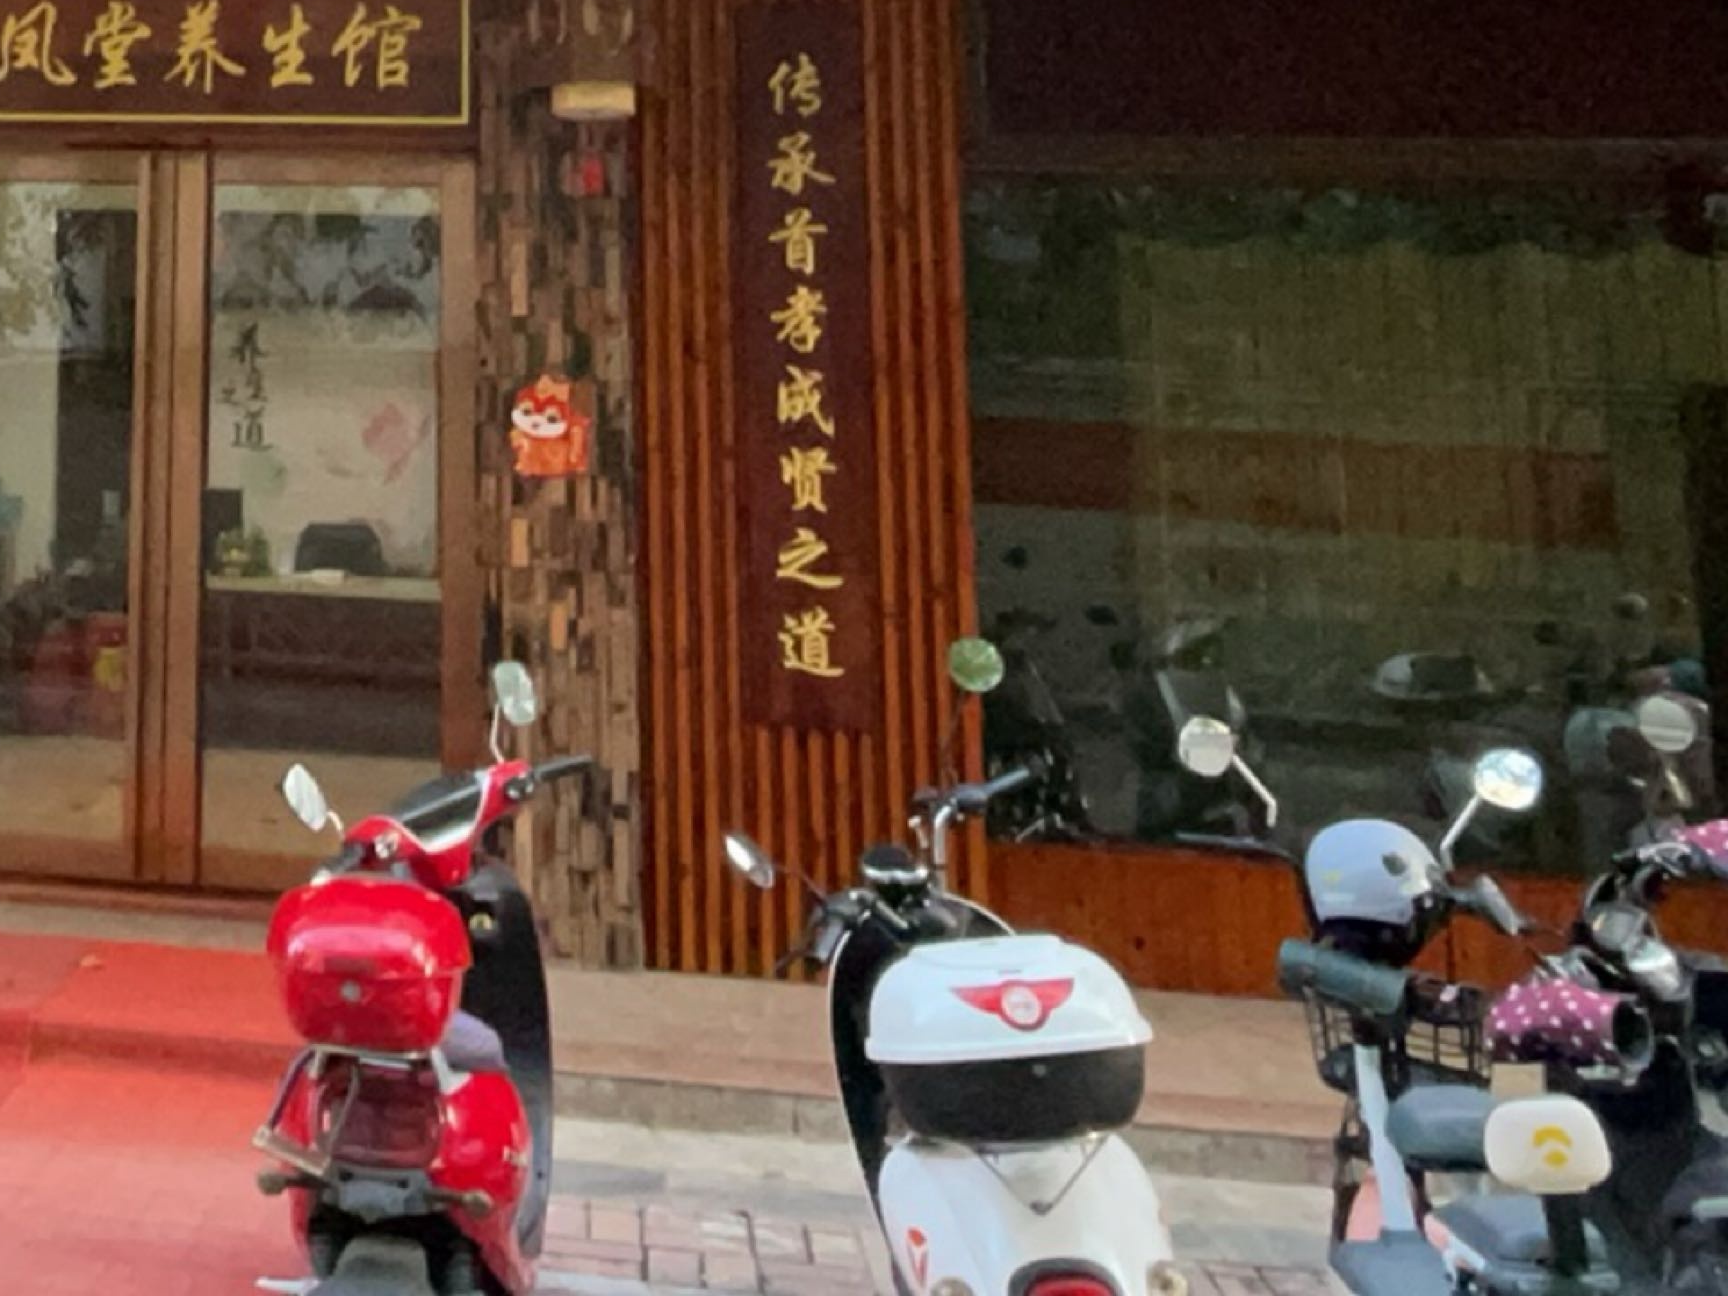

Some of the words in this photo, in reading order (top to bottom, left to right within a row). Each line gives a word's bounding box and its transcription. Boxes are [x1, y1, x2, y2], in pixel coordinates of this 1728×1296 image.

[765, 51, 844, 680] 传承首孝成贤之道
